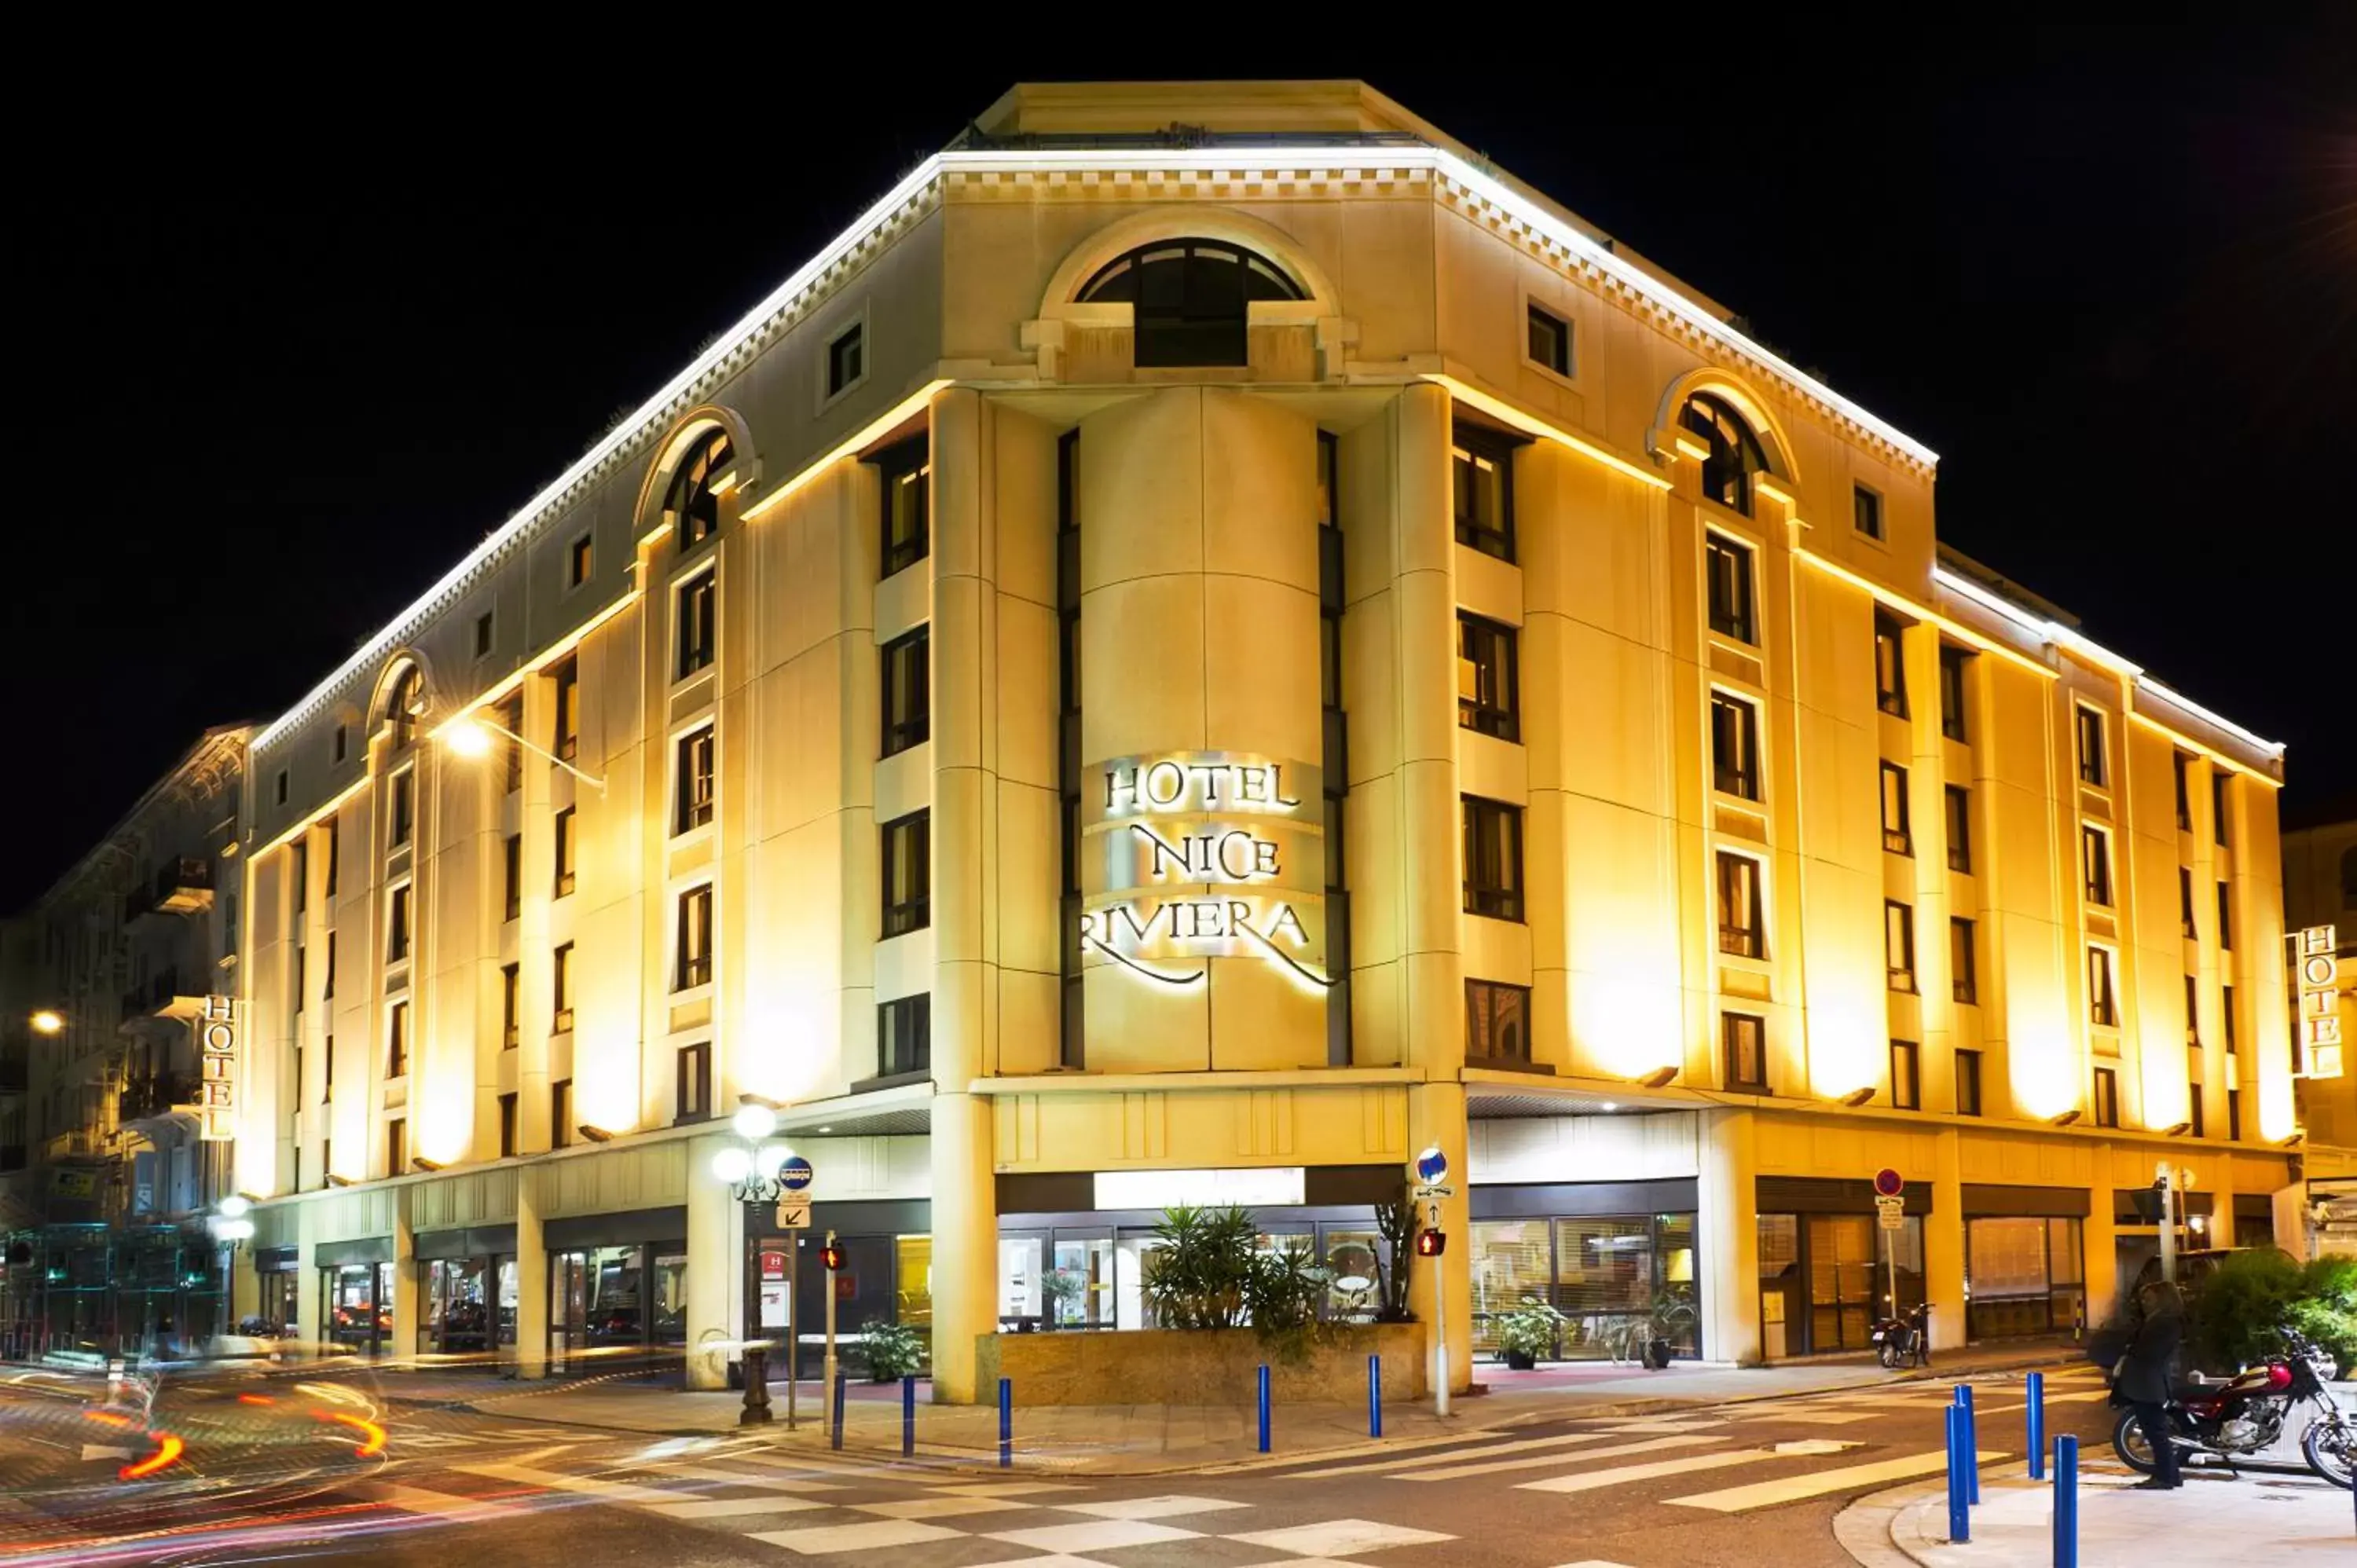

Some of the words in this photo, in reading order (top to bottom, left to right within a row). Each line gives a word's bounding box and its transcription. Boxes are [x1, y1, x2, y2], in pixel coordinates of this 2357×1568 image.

[1105, 761, 1300, 808] HOTEL
[1129, 824, 1281, 879] NICE
[1078, 901, 1339, 987] RIVIERA
[2304, 926, 2340, 1073] HOTEL
[204, 997, 234, 1135] HOTEL
